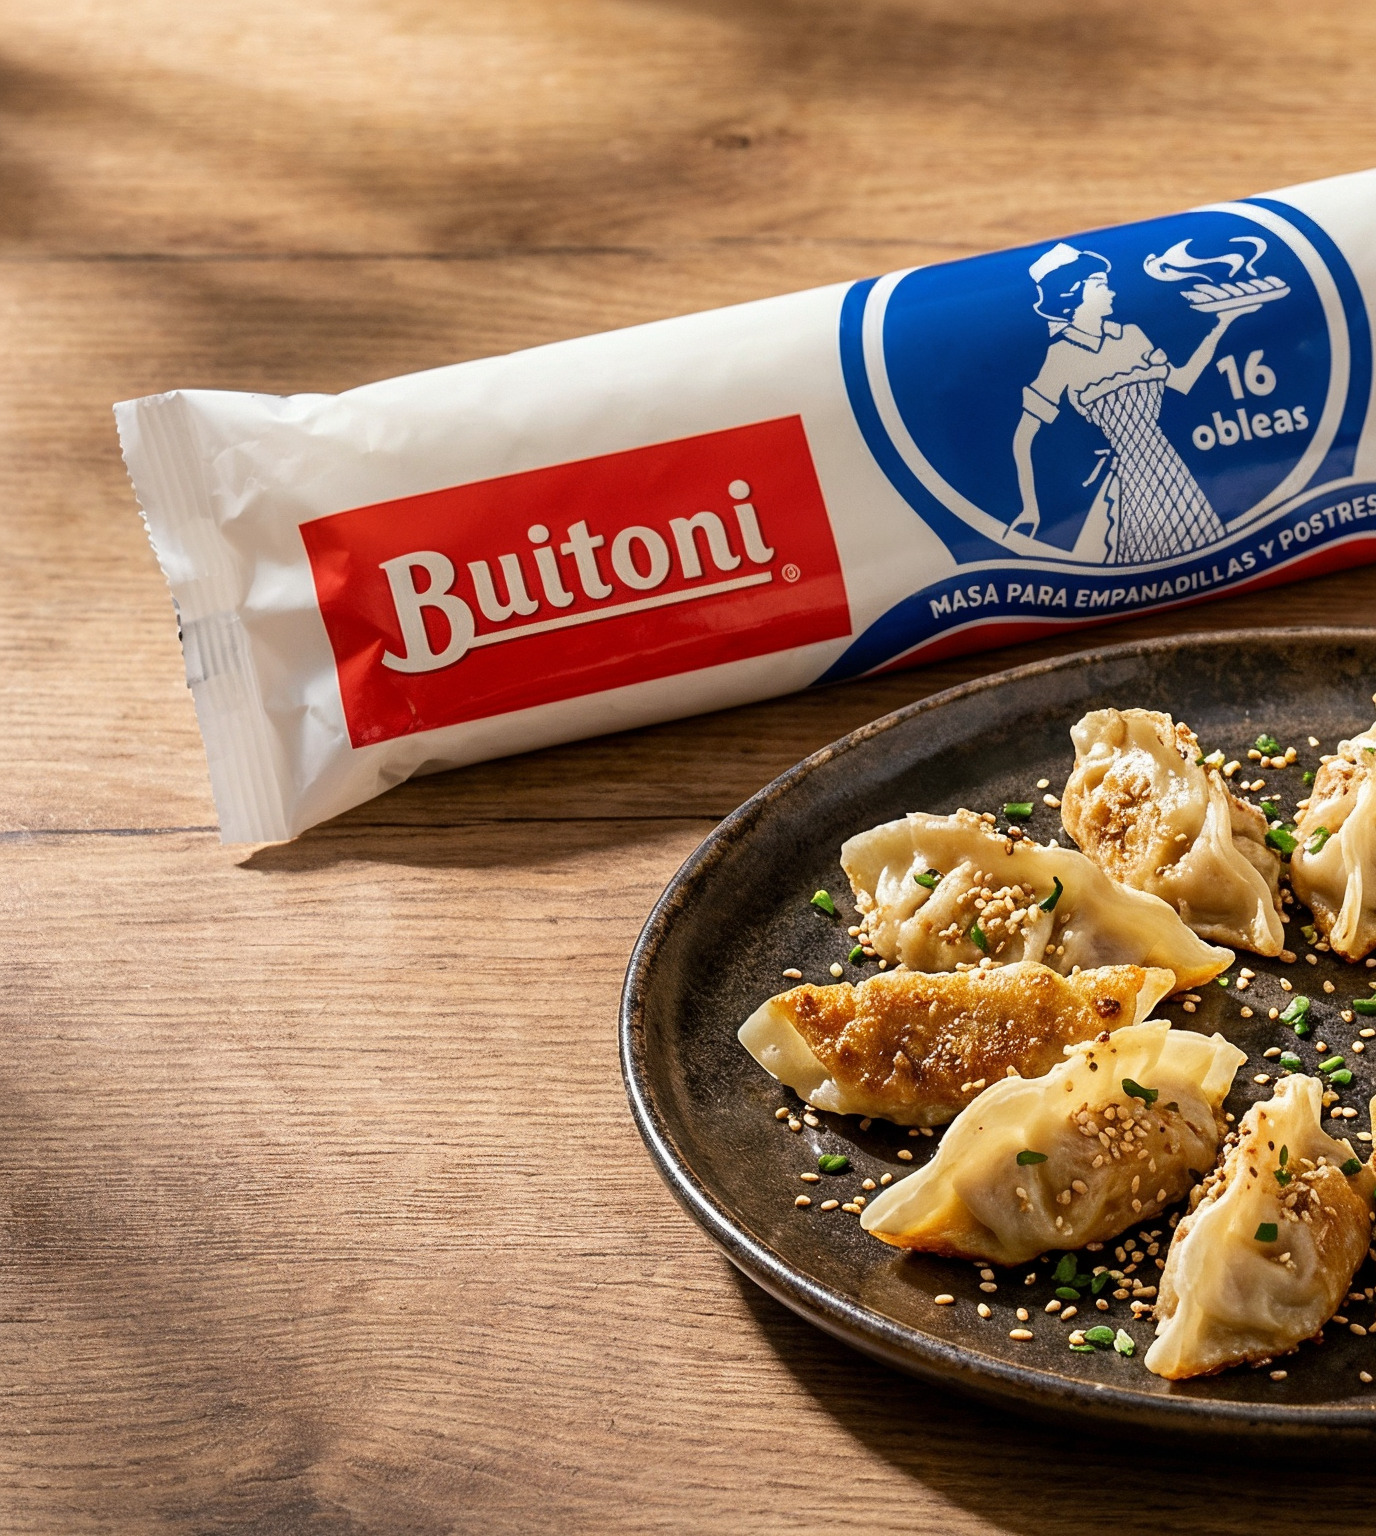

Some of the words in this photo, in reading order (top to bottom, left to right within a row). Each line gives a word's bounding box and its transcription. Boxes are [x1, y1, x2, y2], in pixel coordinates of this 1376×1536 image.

[1216, 349, 1277, 400] 16
[1192, 405, 1309, 451] obleas
[380, 479, 774, 673] Buitoni
[929, 583, 1000, 619] MASA
[1007, 584, 1067, 608] PARA
[1074, 552, 1256, 608] EMPANADILLAS
[1258, 539, 1276, 561] Y
